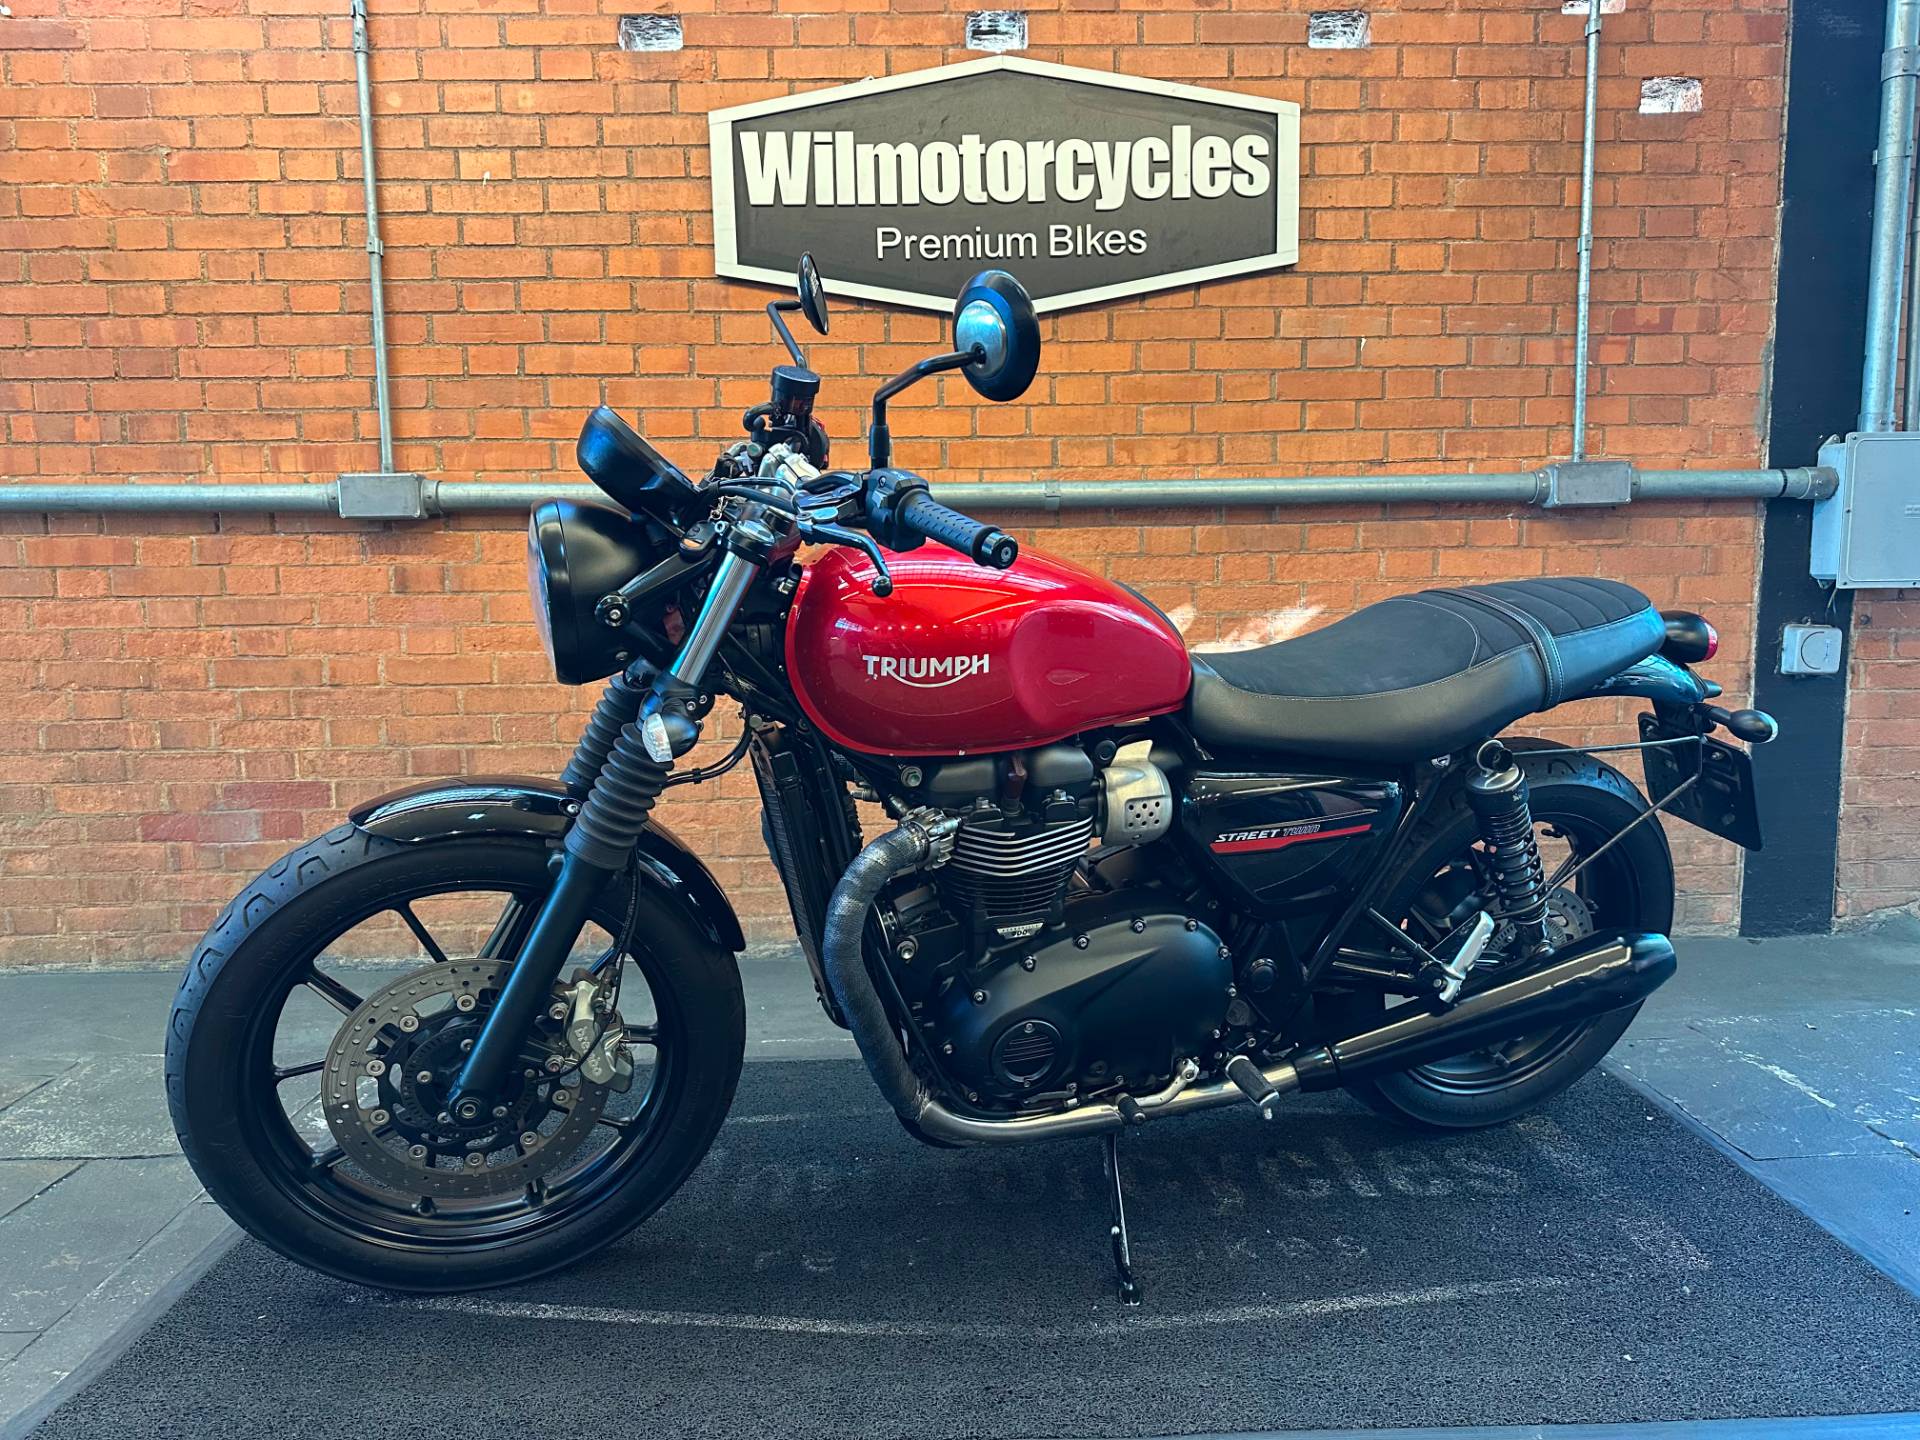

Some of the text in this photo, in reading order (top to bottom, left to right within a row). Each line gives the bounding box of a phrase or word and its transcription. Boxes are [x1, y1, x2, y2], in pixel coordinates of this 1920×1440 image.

[739, 124, 1271, 211] Wilmotorcycles
[876, 225, 1038, 260] Premium
[862, 653, 990, 688] TRIUMPH
[1215, 828, 1281, 843] STREET
